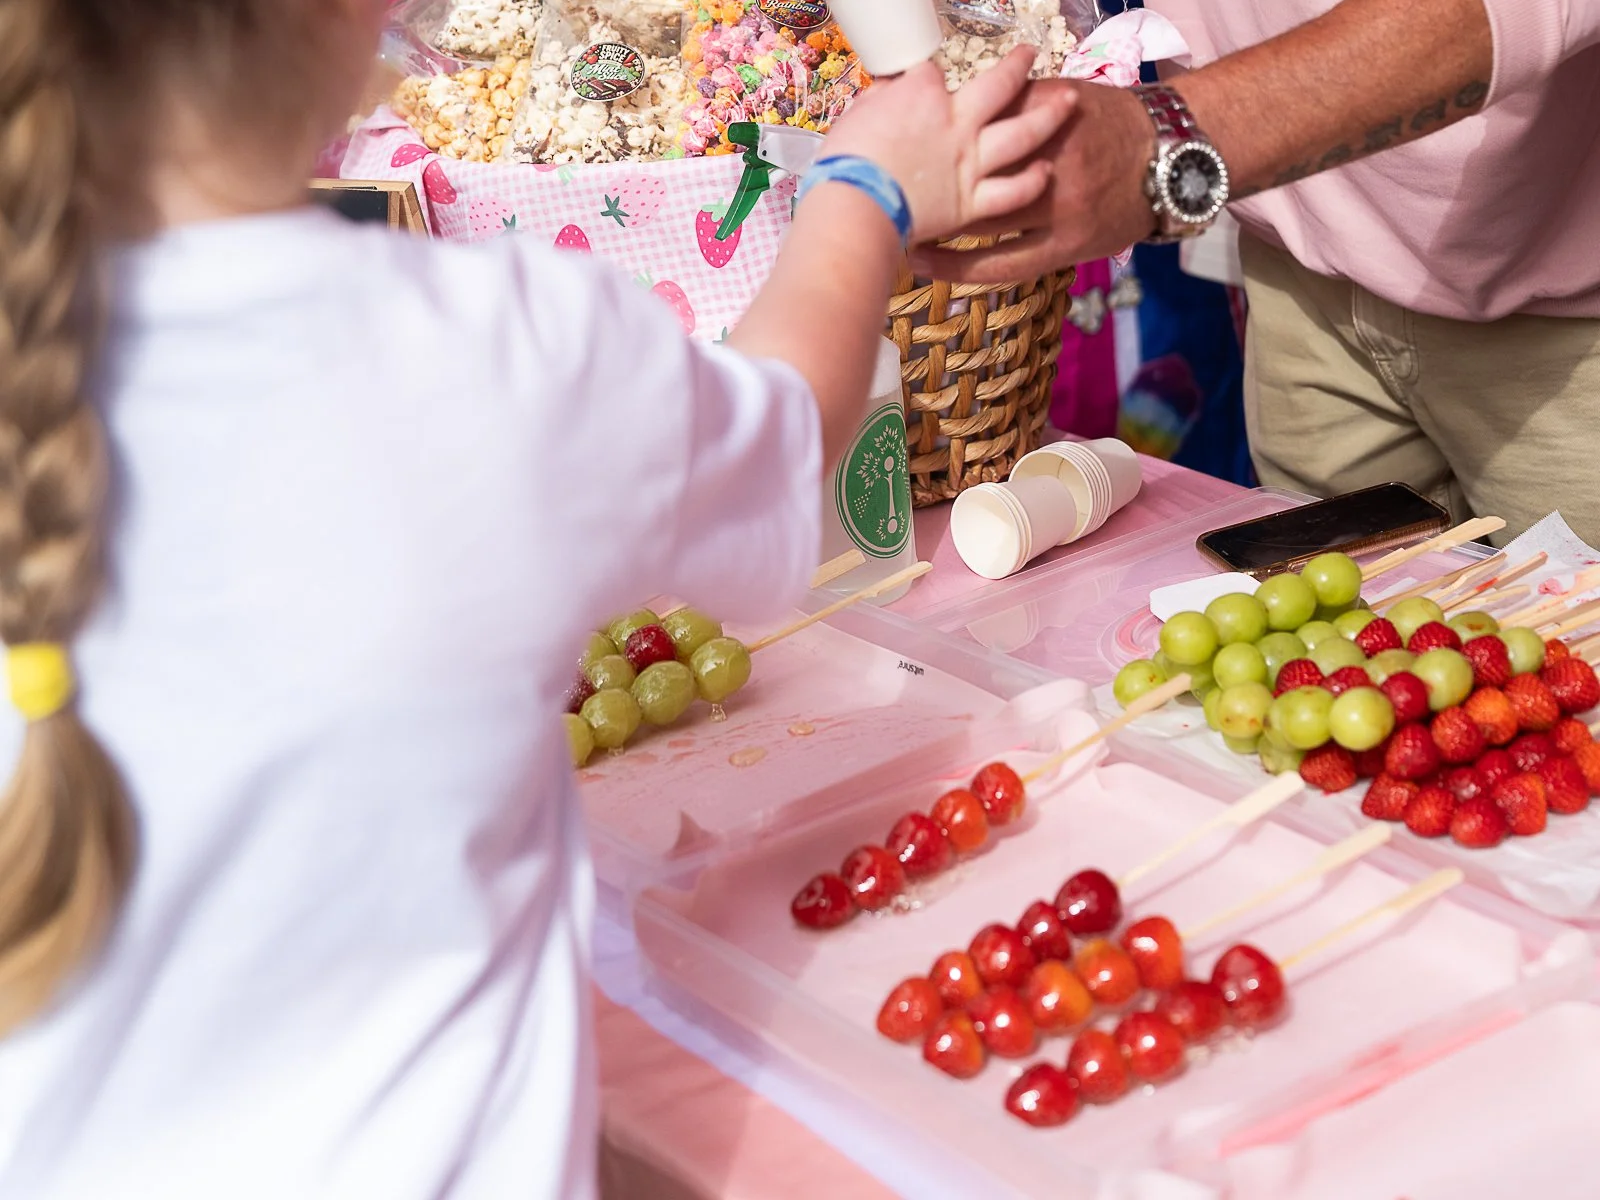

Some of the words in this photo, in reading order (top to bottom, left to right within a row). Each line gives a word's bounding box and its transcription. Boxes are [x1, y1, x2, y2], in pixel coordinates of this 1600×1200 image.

[602, 45, 630, 55] FRUITY
[599, 51, 627, 63] SPICE
[587, 63, 620, 75] Mint
